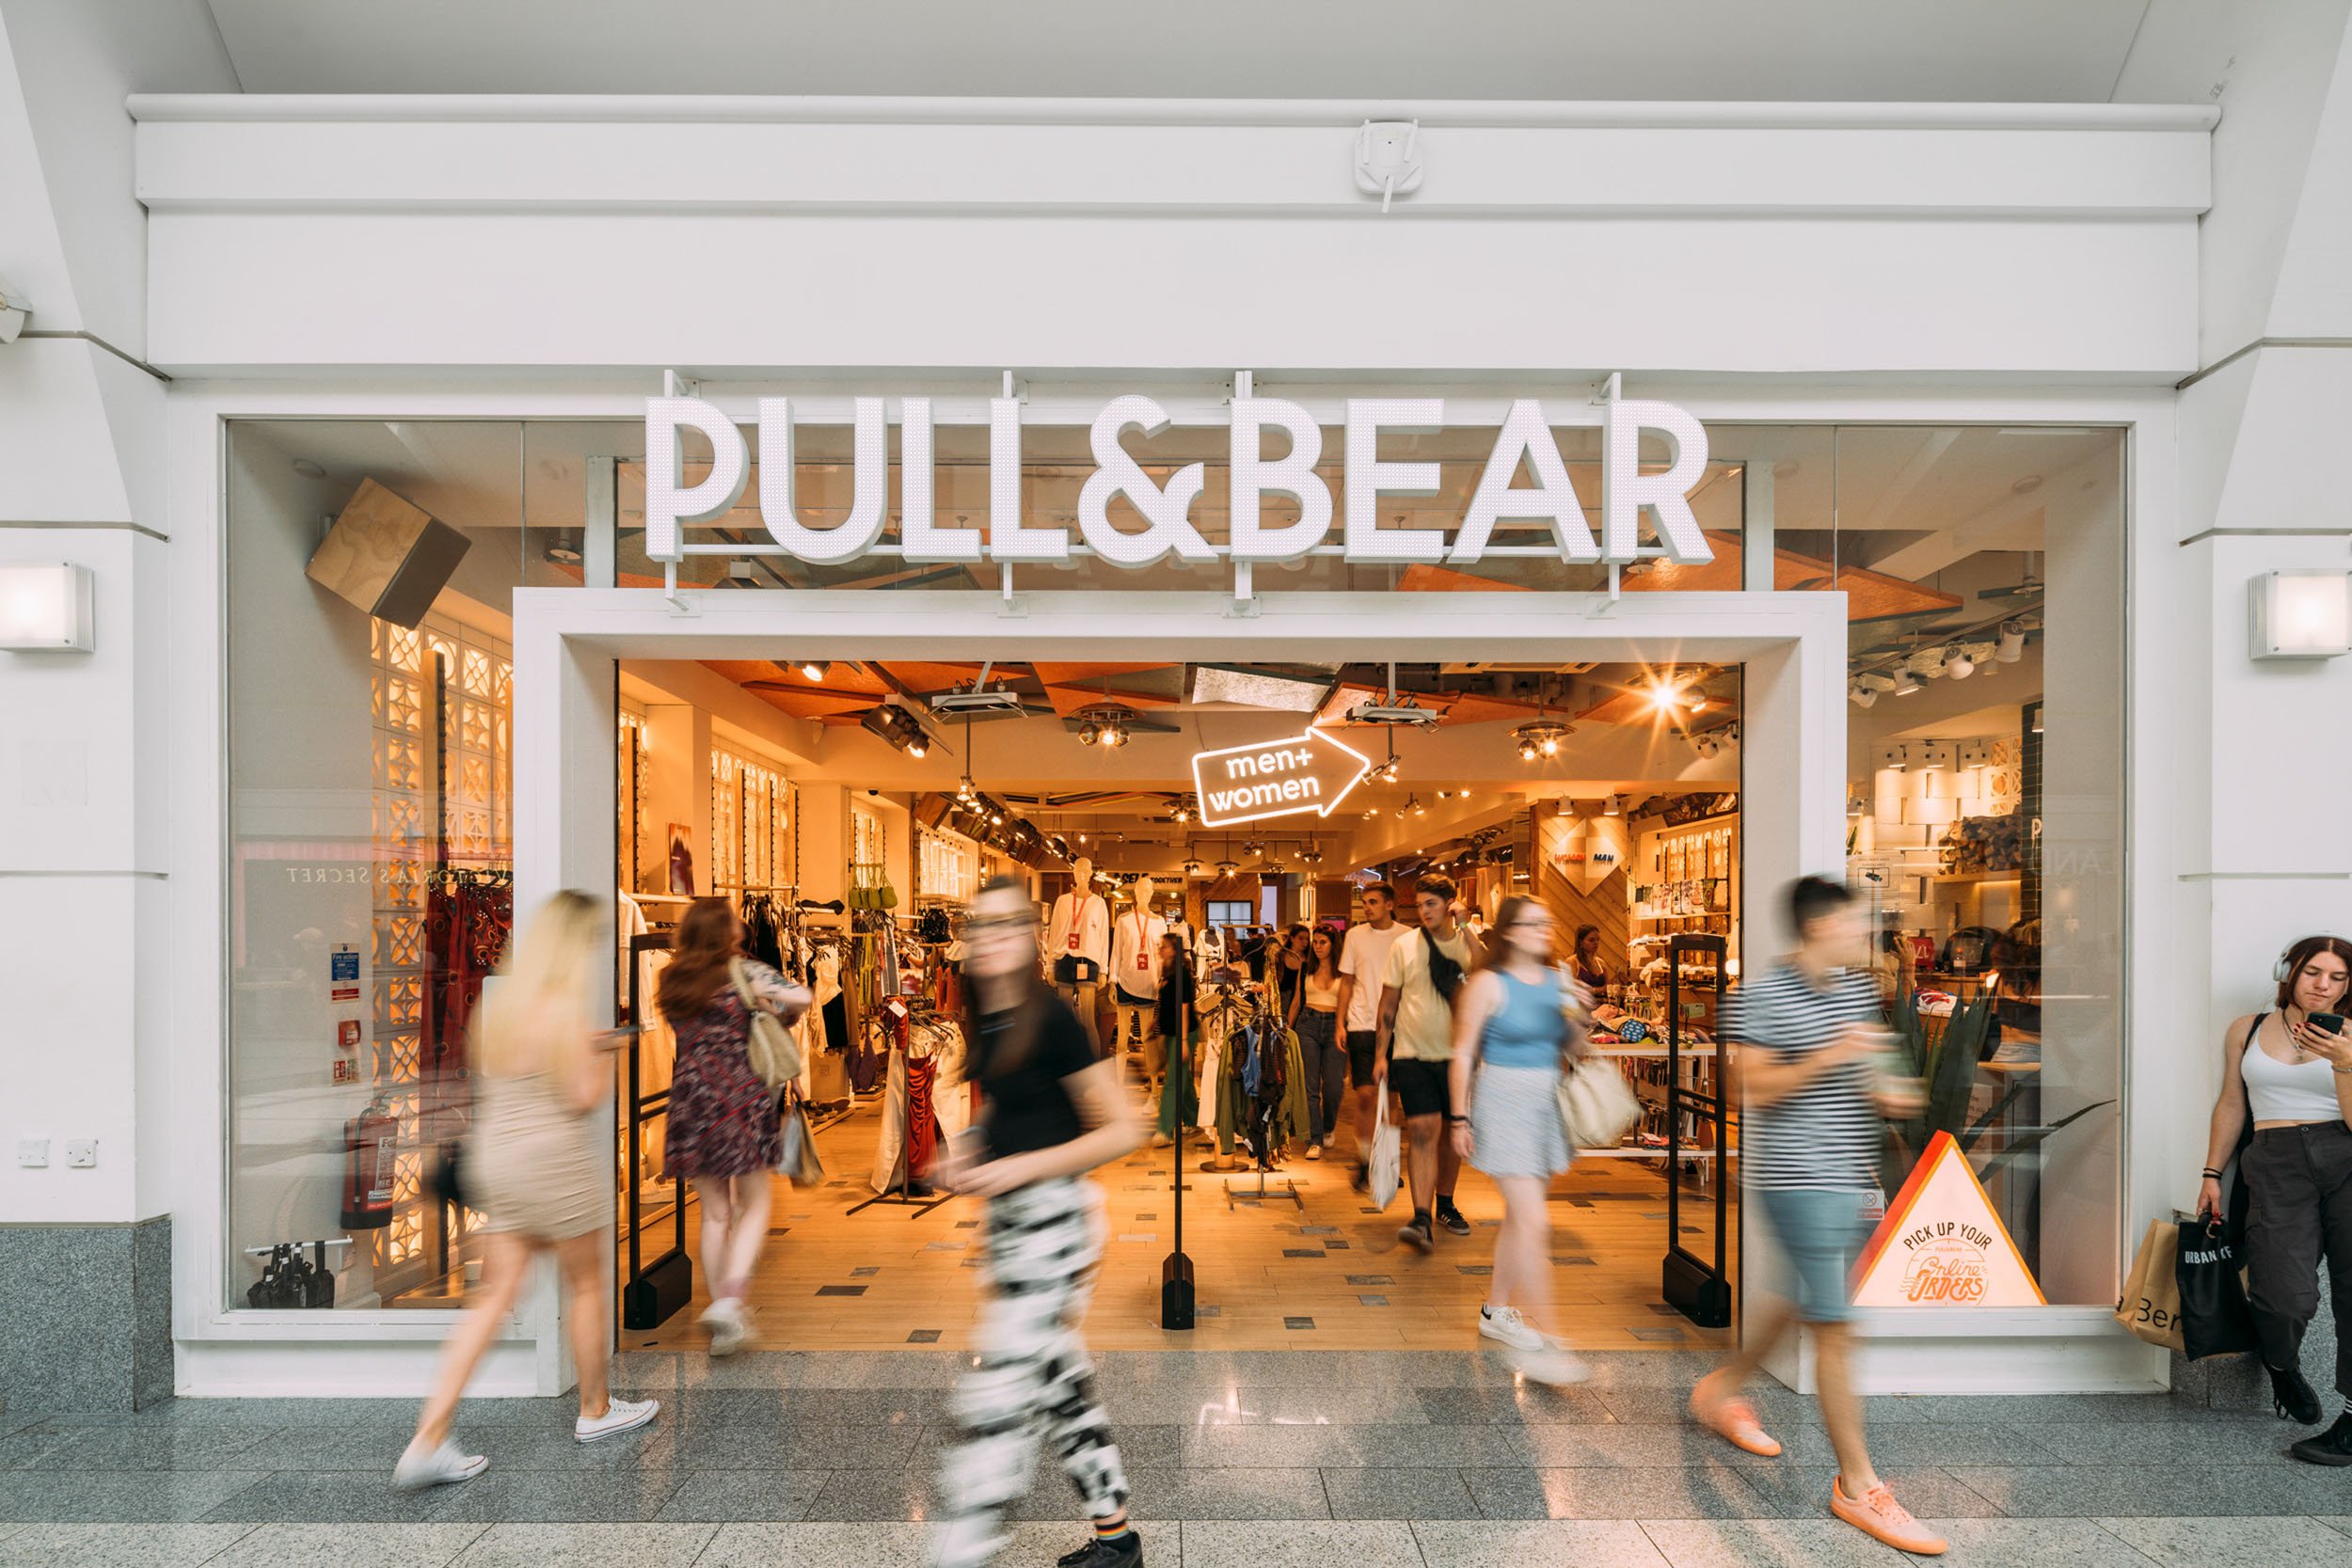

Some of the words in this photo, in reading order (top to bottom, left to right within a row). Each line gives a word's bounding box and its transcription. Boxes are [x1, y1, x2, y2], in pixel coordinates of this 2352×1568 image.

[645, 394, 1715, 565] PULL&BEAR
[1226, 748, 1313, 779] men+
[1208, 776, 1320, 812] women
[1594, 853, 1613, 863] MAN
[1903, 1226, 1934, 1250] PICK
[1937, 1222, 1955, 1236] UP
[1961, 1224, 1993, 1250] YOUR
[2185, 1249, 2217, 1263] URBAN
[2137, 1298, 2183, 1332] Ber
